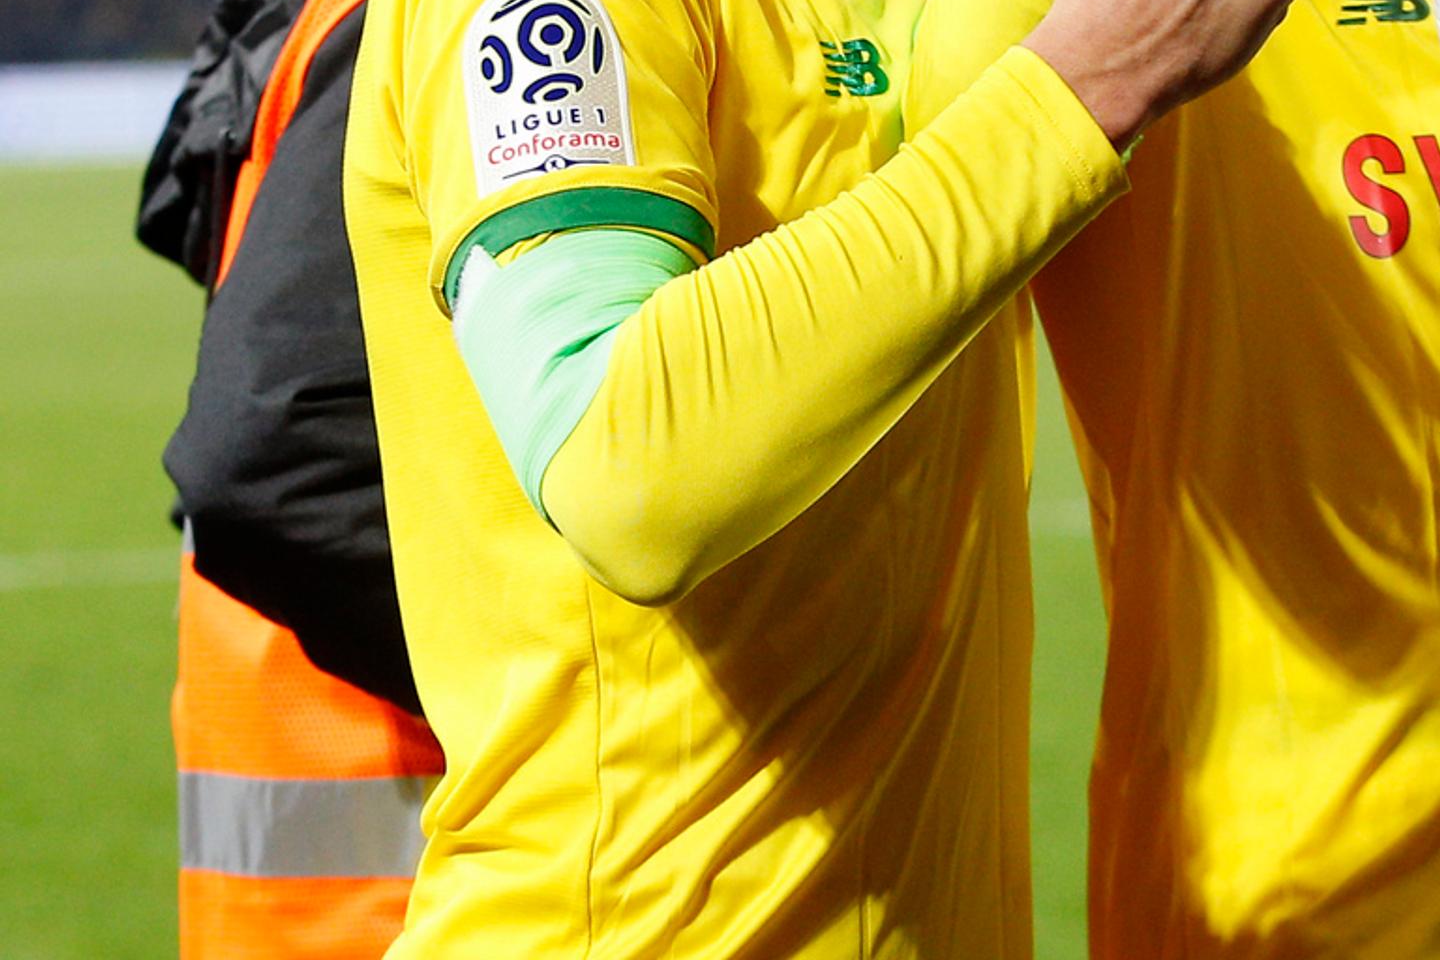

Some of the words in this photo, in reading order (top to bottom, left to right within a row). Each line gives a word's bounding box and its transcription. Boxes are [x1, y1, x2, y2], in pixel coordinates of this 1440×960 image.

[496, 108, 581, 139] LIGUE
[596, 108, 605, 124] 1
[487, 132, 621, 165] Conforama
